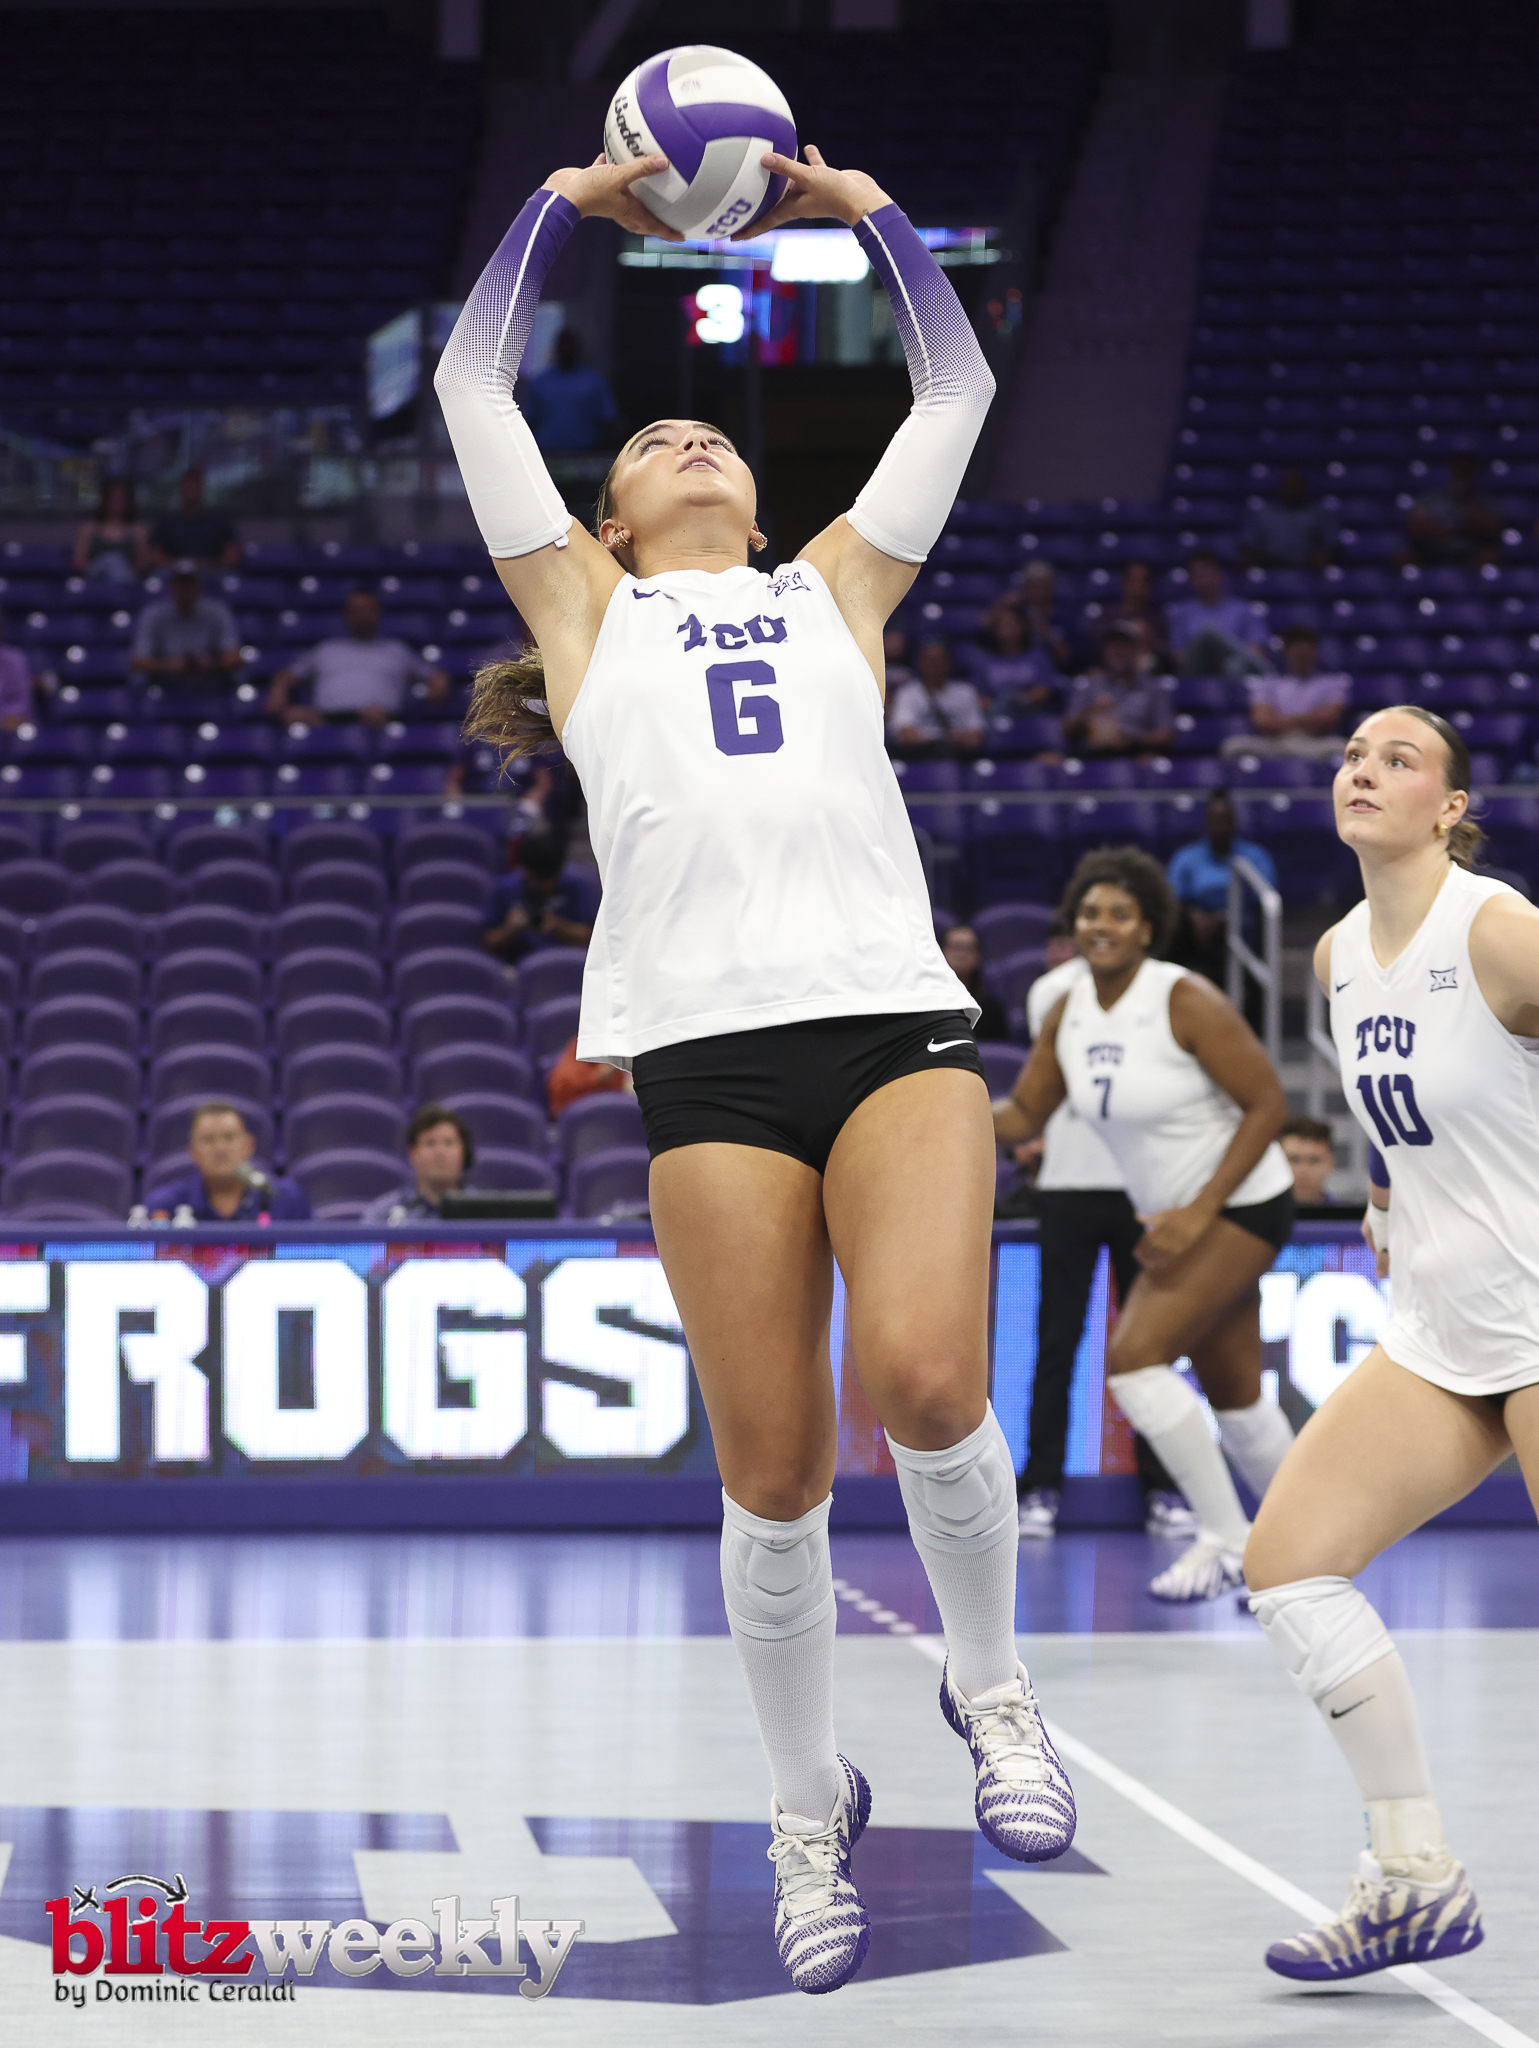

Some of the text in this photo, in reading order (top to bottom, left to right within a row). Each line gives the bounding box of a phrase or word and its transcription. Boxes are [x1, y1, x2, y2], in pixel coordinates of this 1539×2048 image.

[705, 197, 753, 235] TCU
[695, 283, 745, 344] 3
[705, 659, 785, 757] 6
[1356, 1014, 1416, 1061] TCU
[1093, 1076, 1113, 1120] 7
[1356, 1073, 1434, 1148] 10
